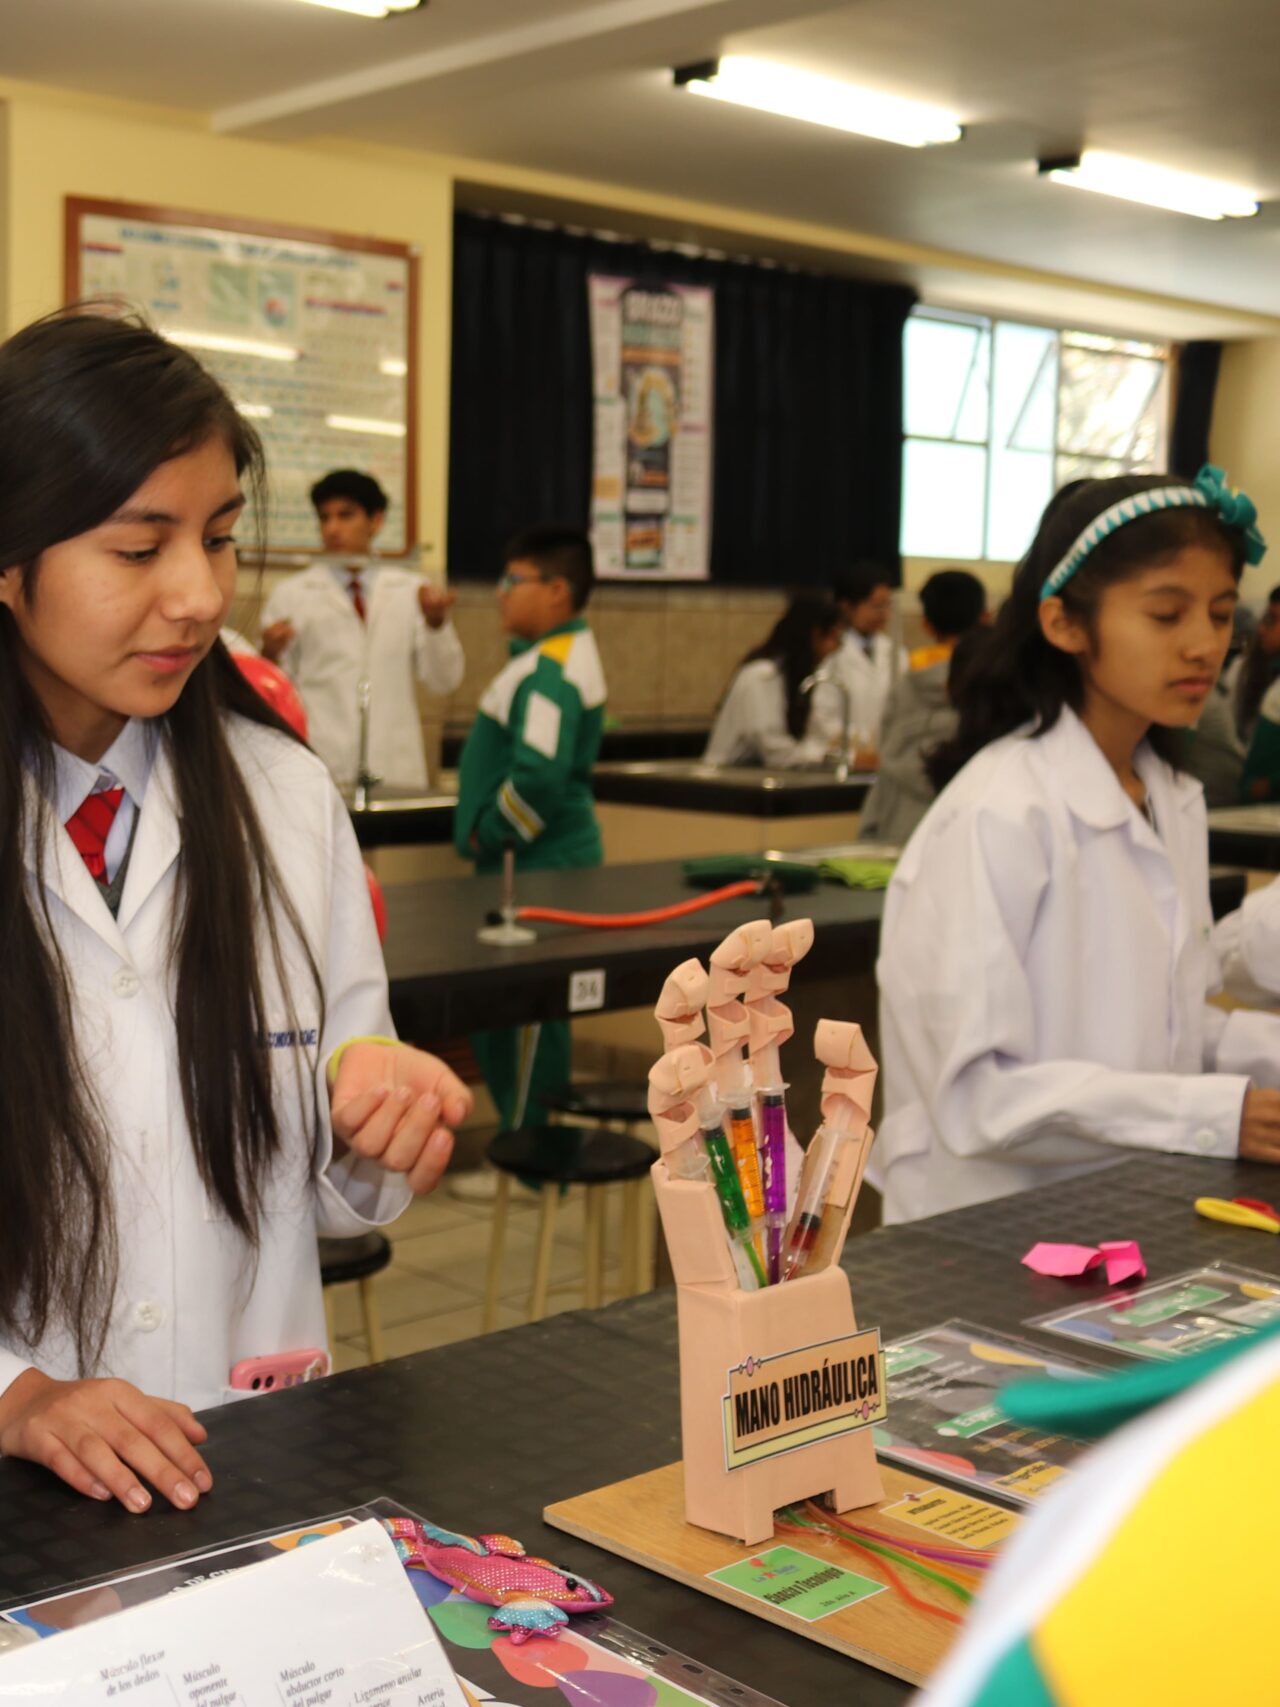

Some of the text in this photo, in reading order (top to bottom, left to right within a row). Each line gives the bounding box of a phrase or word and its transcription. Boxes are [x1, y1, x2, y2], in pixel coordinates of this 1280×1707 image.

[735, 1381, 781, 1438] MANO
[783, 1354, 878, 1422] HIDRÁULICA
[182, 1662, 222, 1685] Músculo
[279, 1660, 316, 1682] Músculo
[285, 1666, 346, 1698] abductor corto
[188, 1678, 228, 1700] oponente
